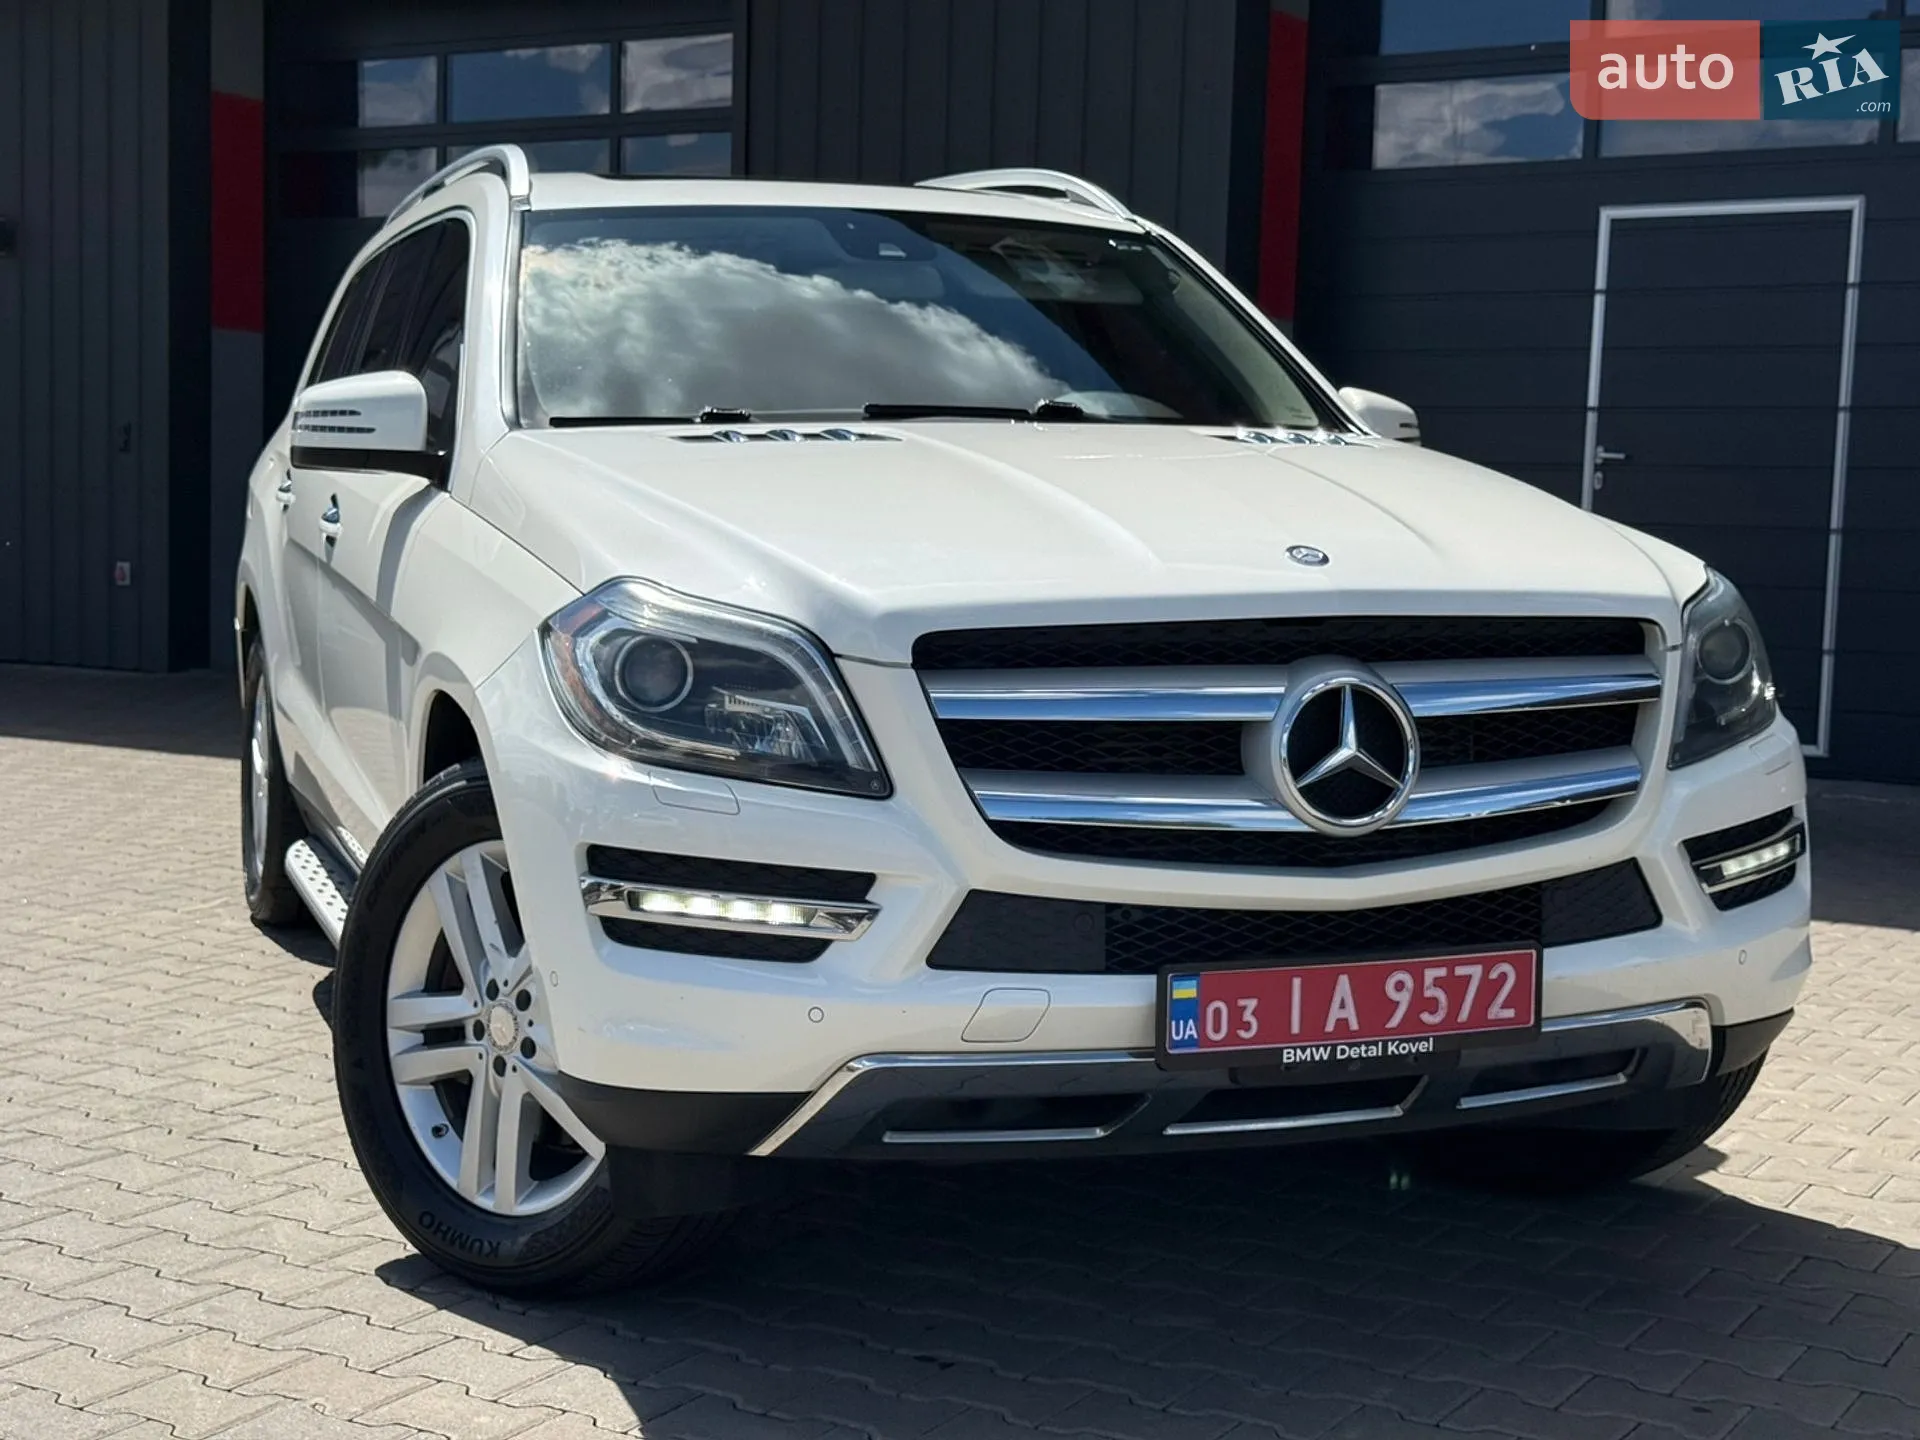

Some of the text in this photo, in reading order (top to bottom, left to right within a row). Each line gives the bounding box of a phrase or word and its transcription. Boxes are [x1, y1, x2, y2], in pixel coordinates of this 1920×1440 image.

[1205, 998, 1259, 1042] 03
[1384, 962, 1517, 1030] 9572
[1171, 1019, 1198, 1042] UA
[1282, 1037, 1434, 1064] BMW Detal Kovel
[418, 1210, 501, 1260] KUMHO
